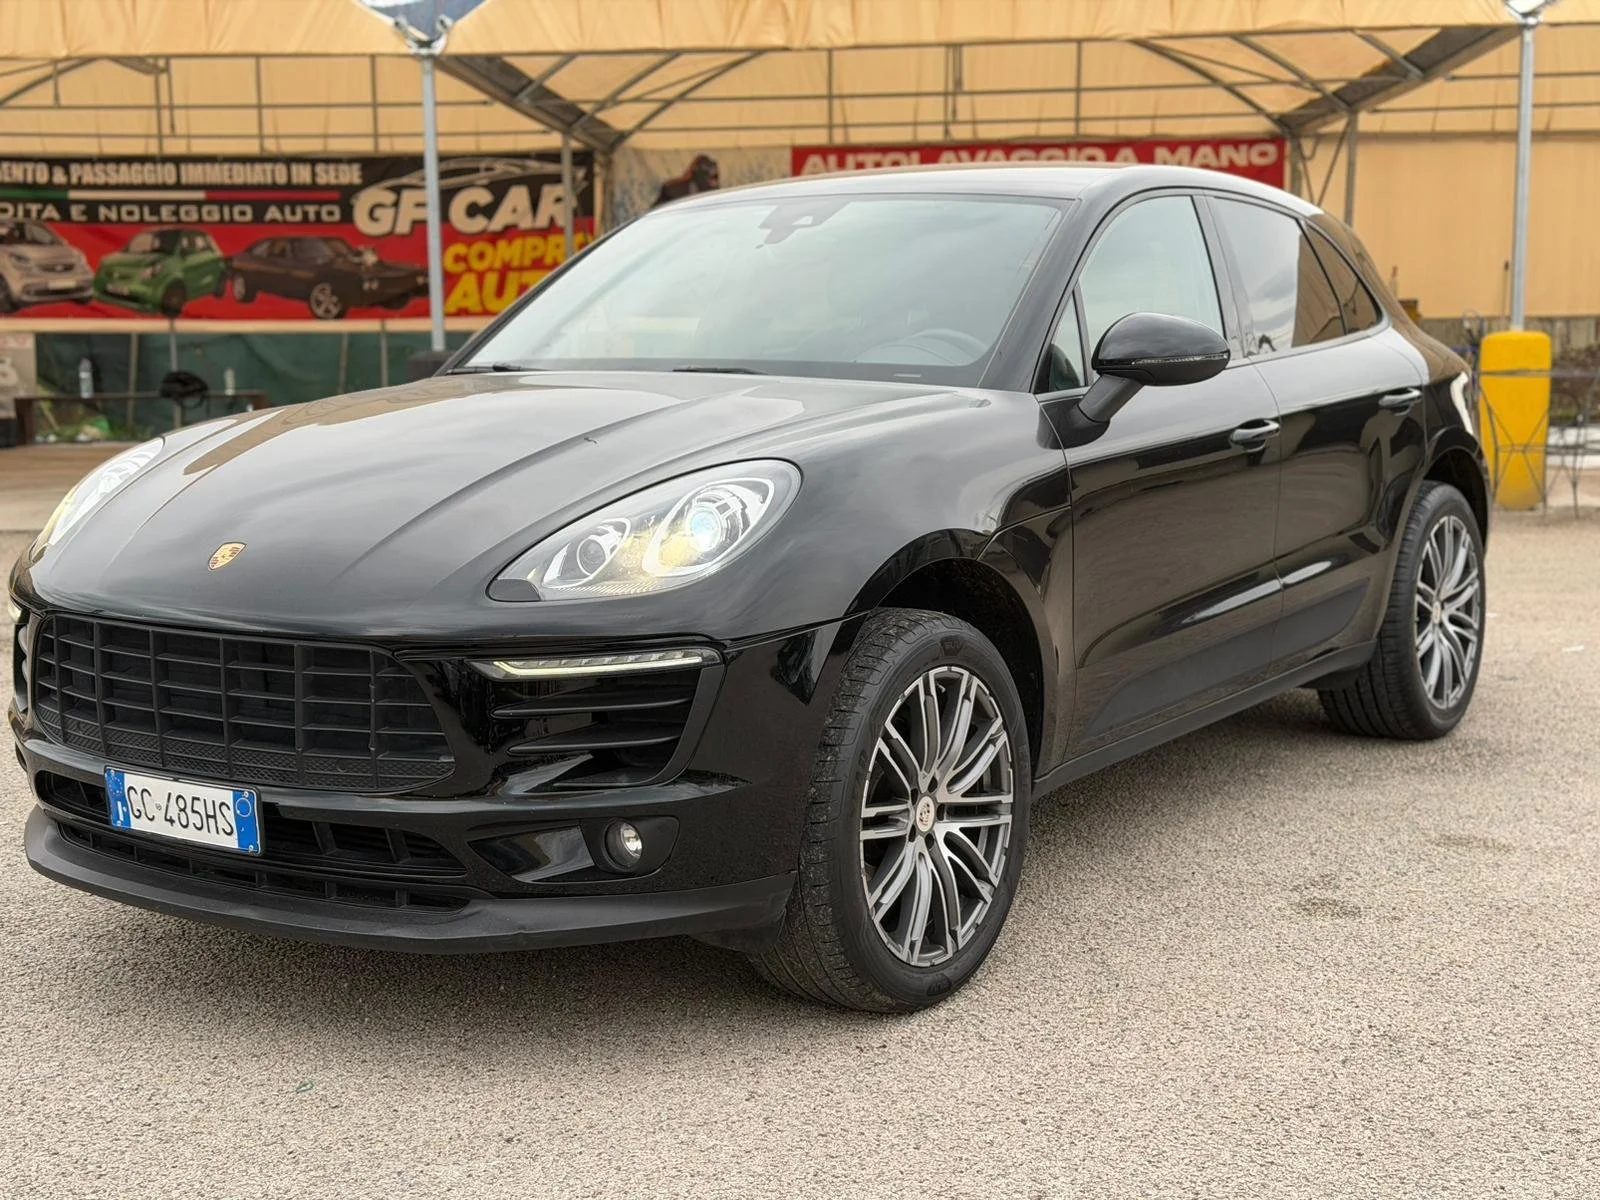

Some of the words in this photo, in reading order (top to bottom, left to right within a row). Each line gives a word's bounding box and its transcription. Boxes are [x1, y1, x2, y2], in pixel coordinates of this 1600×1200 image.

[1154, 143, 1278, 168] MANO
[52, 164, 67, 185] &
[69, 162, 177, 185] PASSAGGIO
[180, 162, 288, 185] IMMEDIATO
[290, 162, 312, 185] IN
[314, 162, 362, 185] SEDE
[70, 204, 88, 222] E
[99, 204, 253, 222] NOLEGGIO
[264, 204, 341, 222] AUTO
[449, 184, 577, 234] CAR
